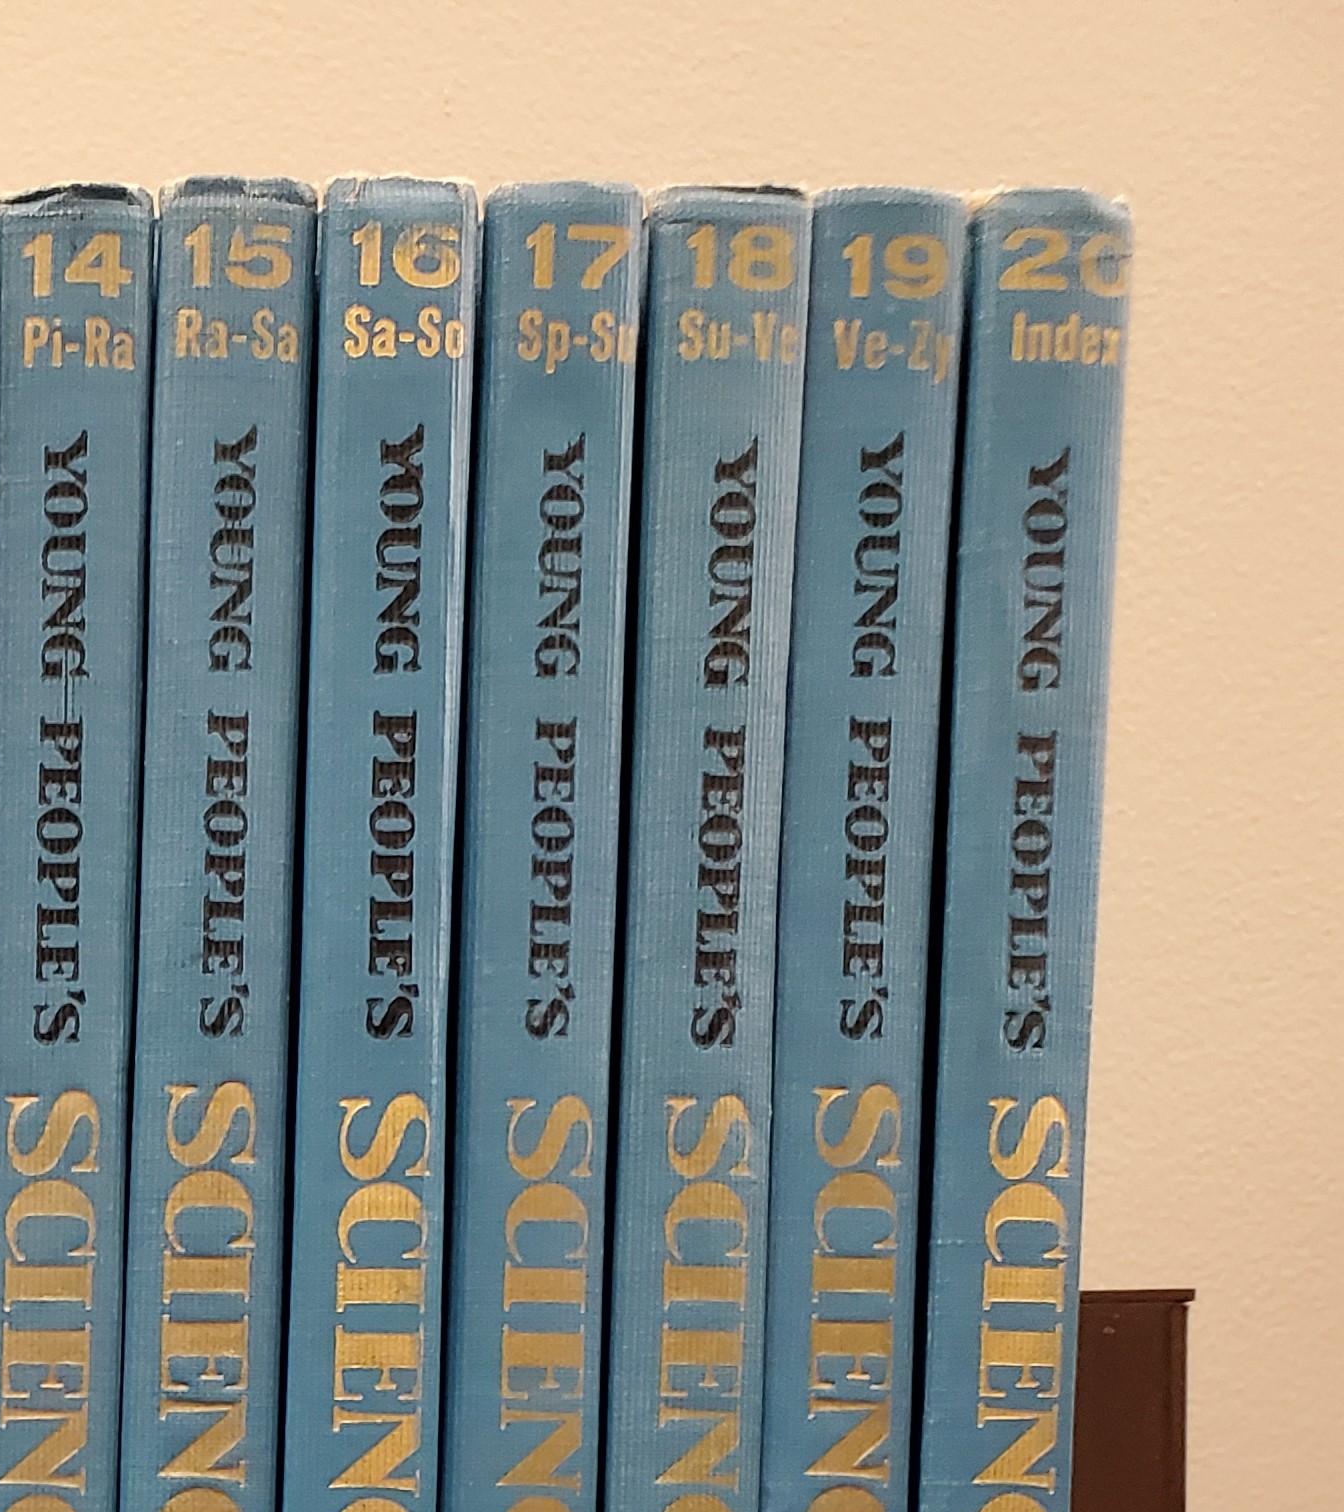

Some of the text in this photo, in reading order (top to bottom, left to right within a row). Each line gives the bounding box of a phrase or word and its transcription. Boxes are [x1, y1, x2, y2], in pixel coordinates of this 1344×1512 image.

[23, 232, 132, 297] 14
[183, 223, 292, 289] 15
[352, 225, 461, 289] 16
[526, 223, 632, 289] 17
[687, 224, 794, 290] 18
[842, 234, 948, 299] 19
[999, 227, 1132, 299] 20
[23, 315, 134, 369] Pi-Ra
[175, 306, 298, 362] Ra-Sa
[344, 305, 465, 358] Sa-So
[678, 308, 799, 363] Su-Ve
[1012, 311, 1125, 365] Index
[209, 424, 258, 672] YOUNG
[534, 431, 586, 678] YOUNG
[1018, 445, 1072, 691] YOUNG
[199, 709, 250, 1038] PEOPLE'S
[525, 716, 577, 1039] PEOPLE'S
[1002, 730, 1058, 1051] PEOPLE'S
